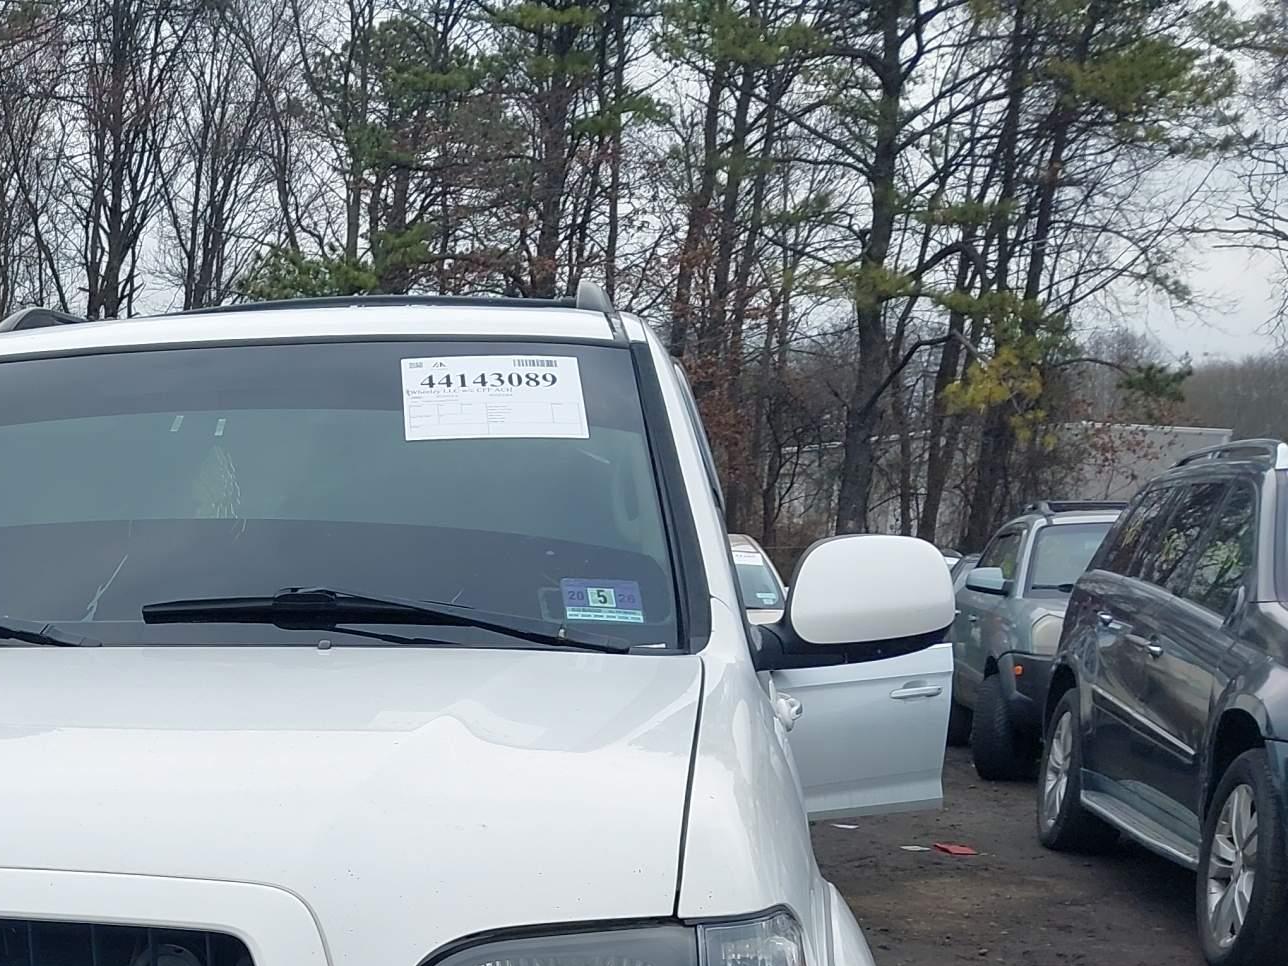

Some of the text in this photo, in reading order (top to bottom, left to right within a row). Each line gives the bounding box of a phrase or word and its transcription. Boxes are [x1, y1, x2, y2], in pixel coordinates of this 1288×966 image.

[420, 372, 558, 389] 44143089
[567, 590, 585, 601] 20
[596, 589, 608, 605] 5
